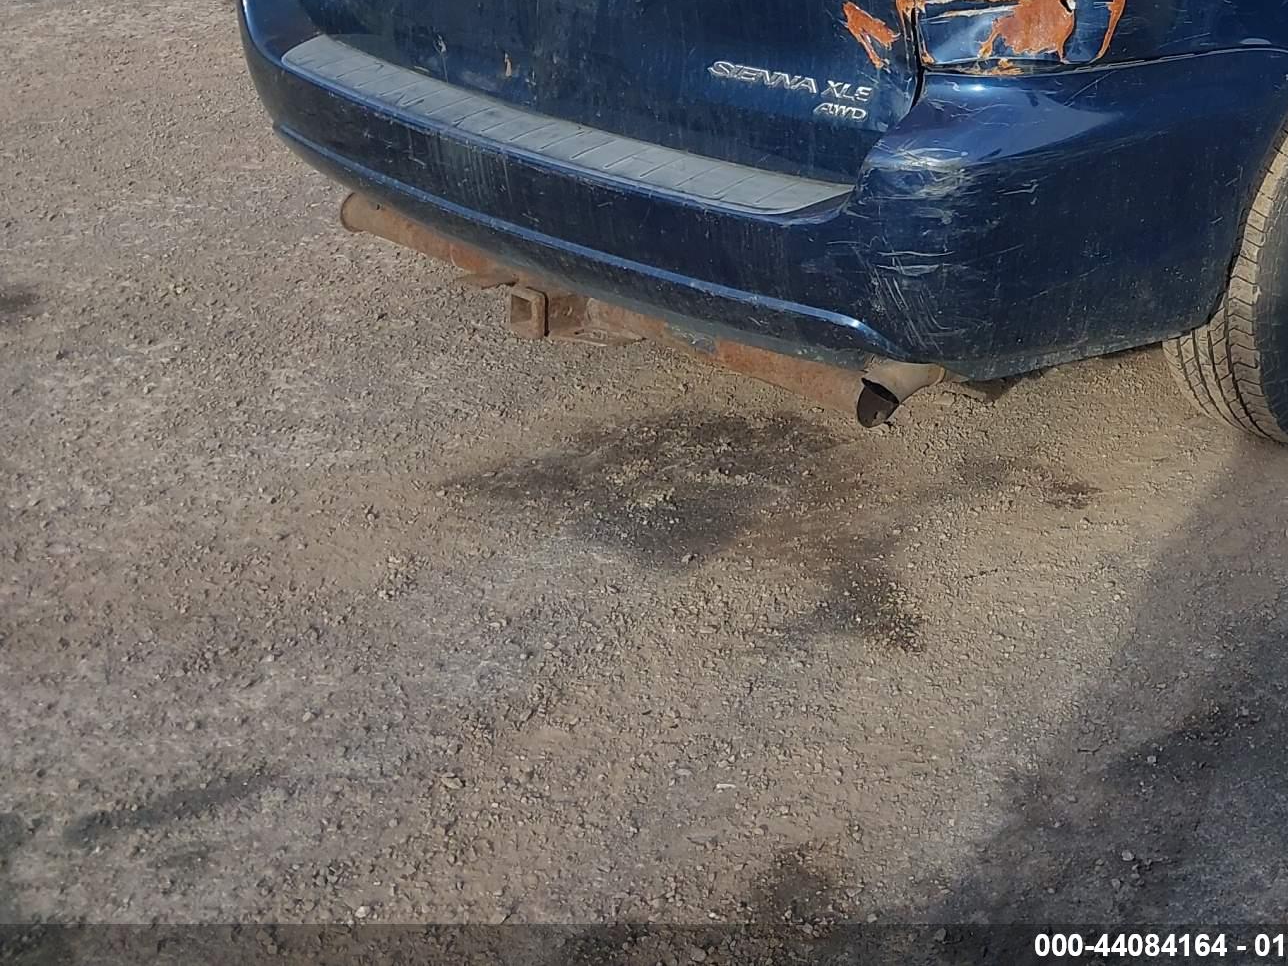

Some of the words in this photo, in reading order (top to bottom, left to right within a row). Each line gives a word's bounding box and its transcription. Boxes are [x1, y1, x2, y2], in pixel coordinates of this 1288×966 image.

[707, 60, 817, 94] SIENNA
[819, 79, 874, 102] XLE
[812, 101, 868, 122] AWD
